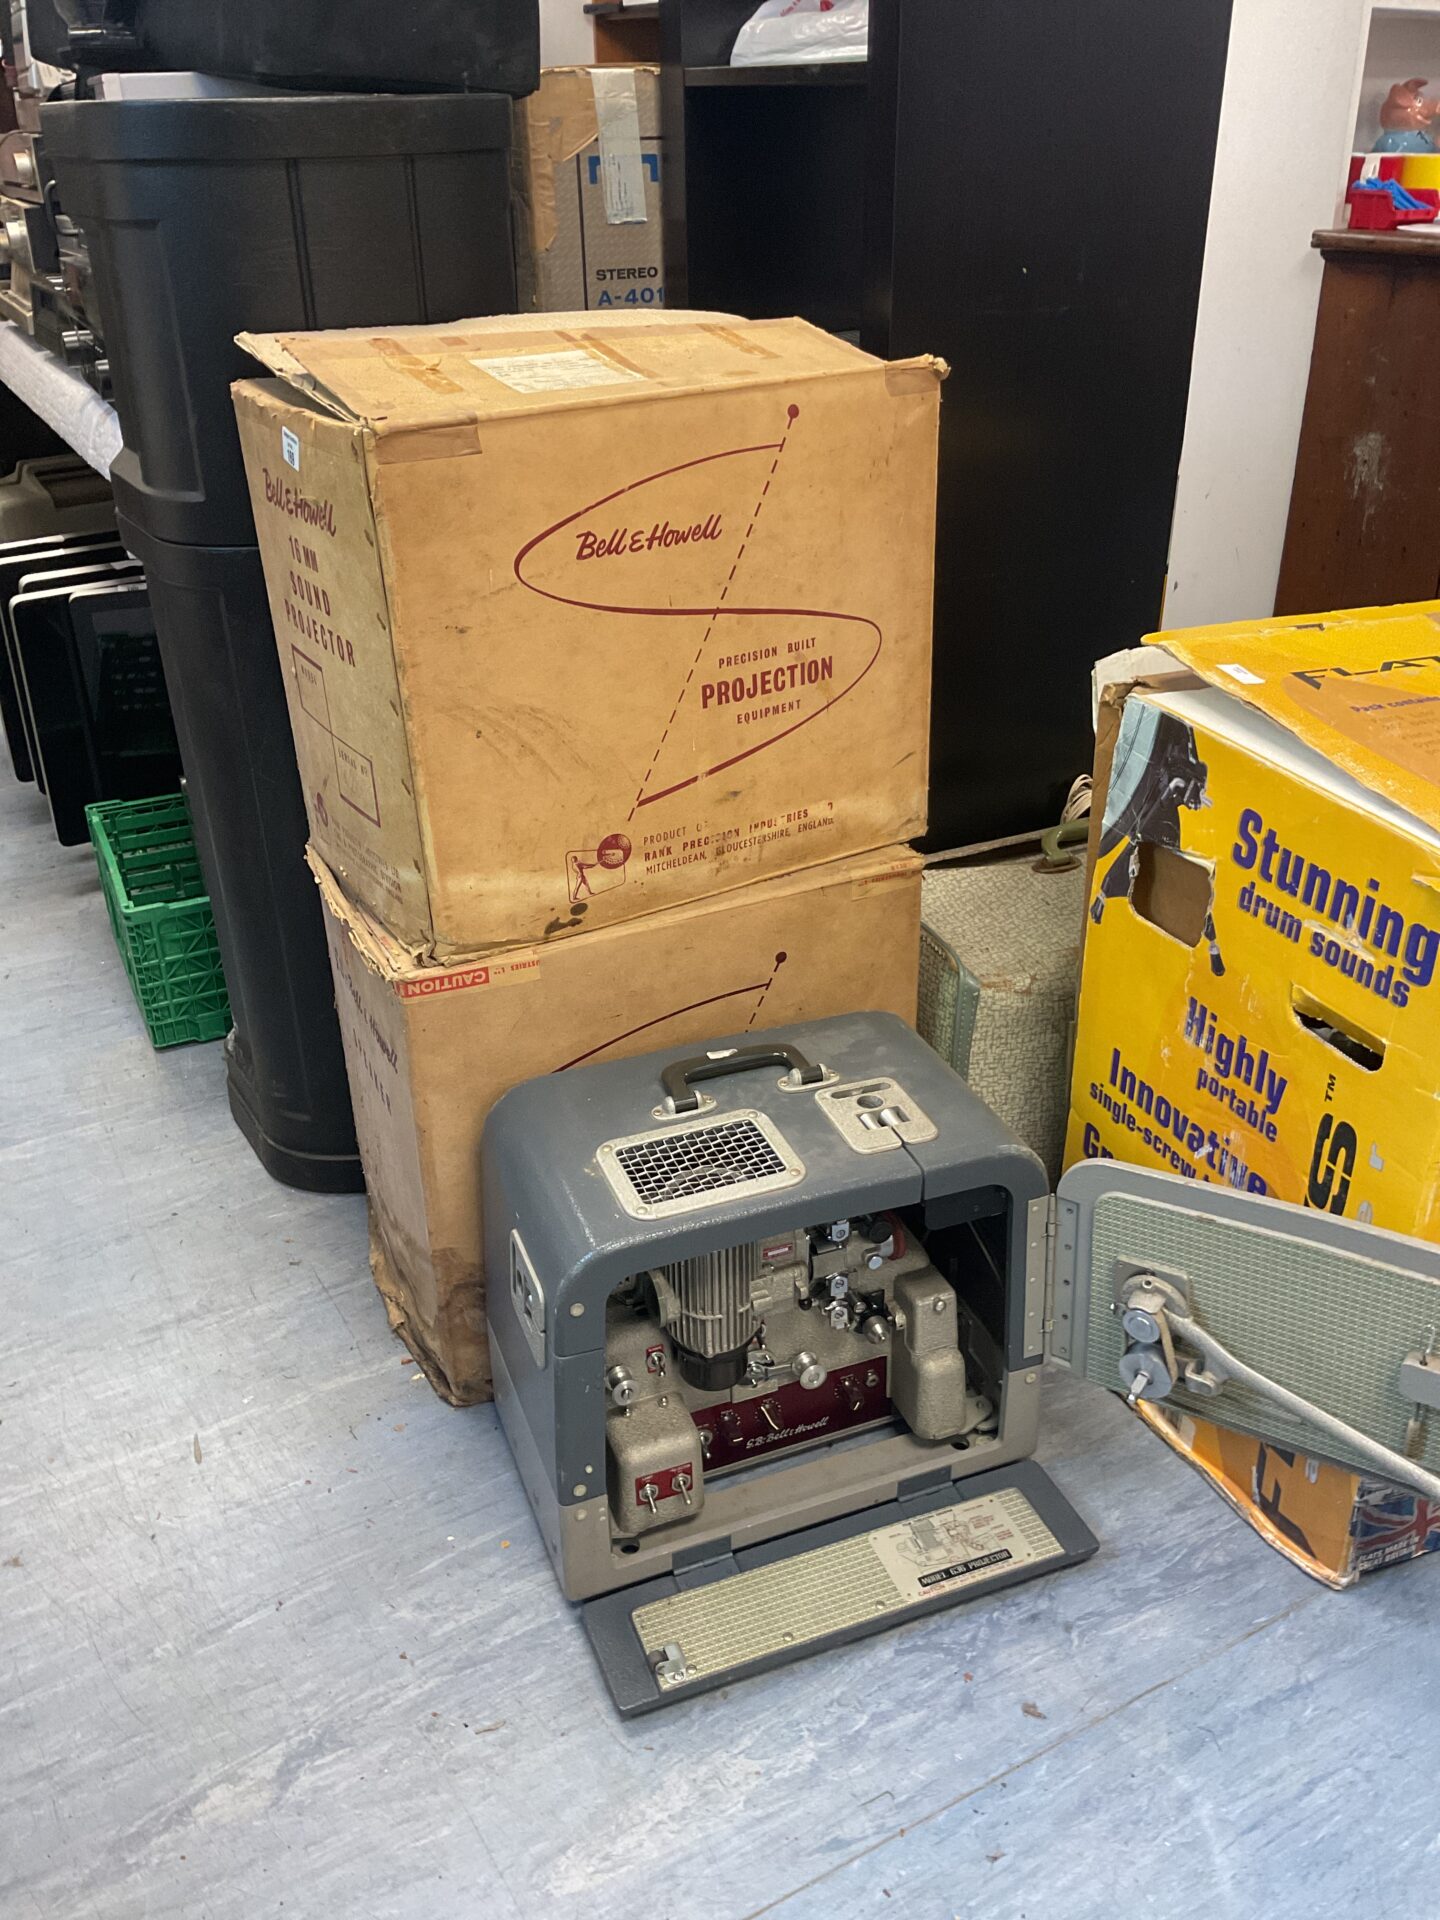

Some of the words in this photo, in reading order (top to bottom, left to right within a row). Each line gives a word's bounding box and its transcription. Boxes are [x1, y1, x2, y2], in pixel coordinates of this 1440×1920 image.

[596, 266, 658, 281] STEREO
[262, 467, 285, 512] Bell
[293, 487, 337, 537] Howell
[289, 535, 301, 563] 16
[302, 545, 319, 573] MM
[576, 528, 628, 560] Bell
[645, 513, 723, 551] Howell
[290, 570, 331, 616] SOUND
[284, 598, 356, 667] PROJECTOR
[718, 646, 778, 669] PRECISION
[787, 637, 816, 654] BUILT
[701, 656, 833, 709] PROJECTION
[736, 699, 801, 725] EQUIPMENT
[643, 826, 687, 846] PRODUCT
[644, 846, 673, 862] RANK
[1232, 808, 1440, 987] Stunning
[1237, 880, 1303, 943] drum
[1310, 930, 1411, 1008] sounds
[407, 970, 487, 995] CAUTION
[1186, 996, 1288, 1115] Highly
[1109, 1048, 1267, 1196] Innovative
[1196, 1067, 1278, 1143] portable
[1089, 1081, 1197, 1180] single-screw
[920, 1573, 949, 1587] MODEL
[967, 1550, 1010, 1570] PROJECTOR
